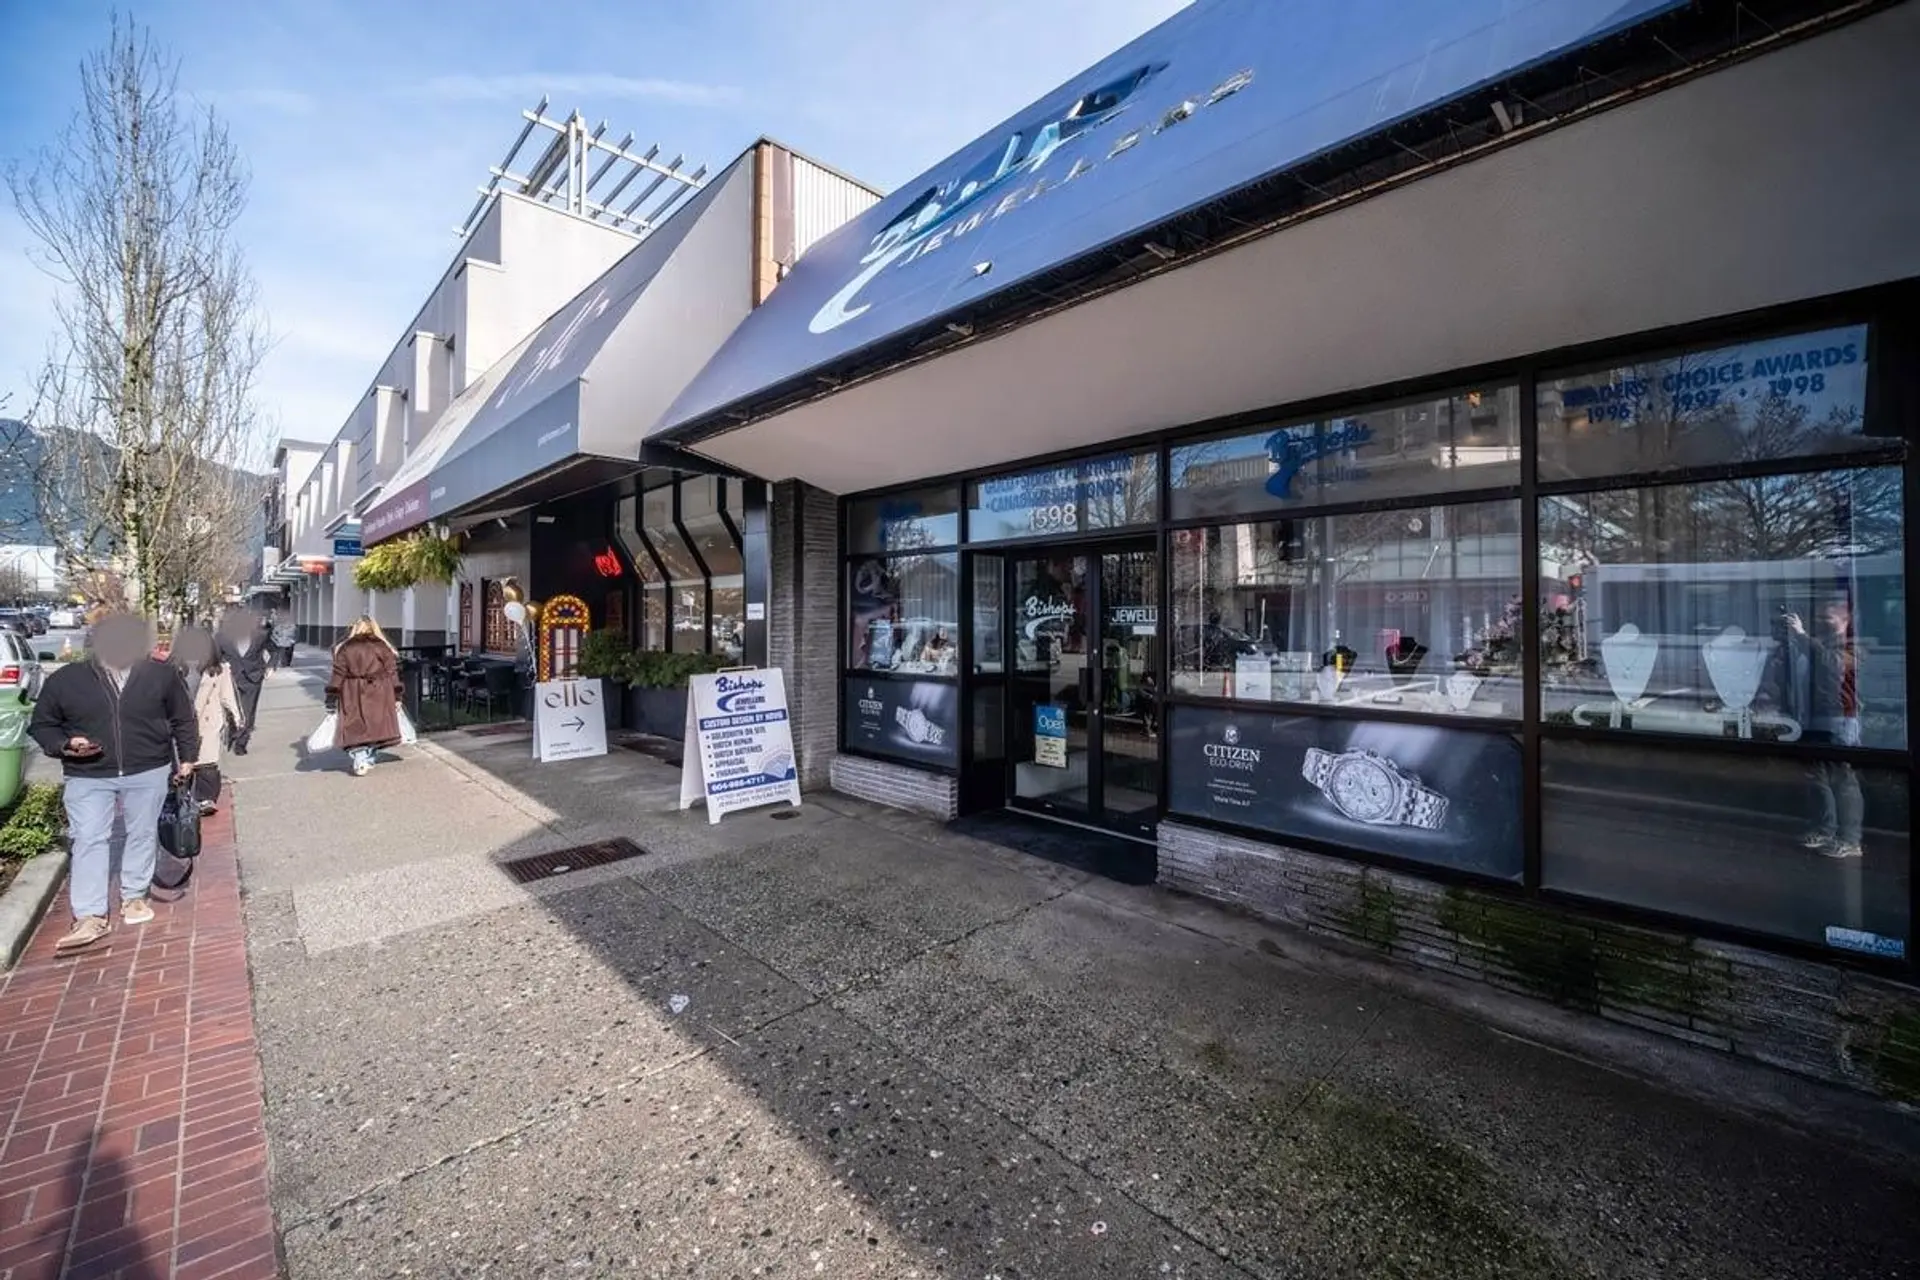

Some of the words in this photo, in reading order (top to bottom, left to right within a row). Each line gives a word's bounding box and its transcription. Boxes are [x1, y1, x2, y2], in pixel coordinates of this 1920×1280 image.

[1663, 361, 1744, 393] CHOICE
[1751, 343, 1858, 378] AWARDS
[1586, 401, 1631, 425] 1996
[1768, 373, 1825, 398] 1998
[1029, 503, 1078, 530] 1598
[1025, 595, 1077, 622] Bishops
[544, 682, 598, 709] elle
[715, 676, 766, 694] Bishops
[731, 715, 755, 726] DESIGN
[755, 713, 764, 722] BY
[712, 741, 732, 750] WATCH
[734, 737, 753, 745] REPAIR
[713, 750, 734, 759] WATCH
[1203, 744, 1261, 763] CITIZEN
